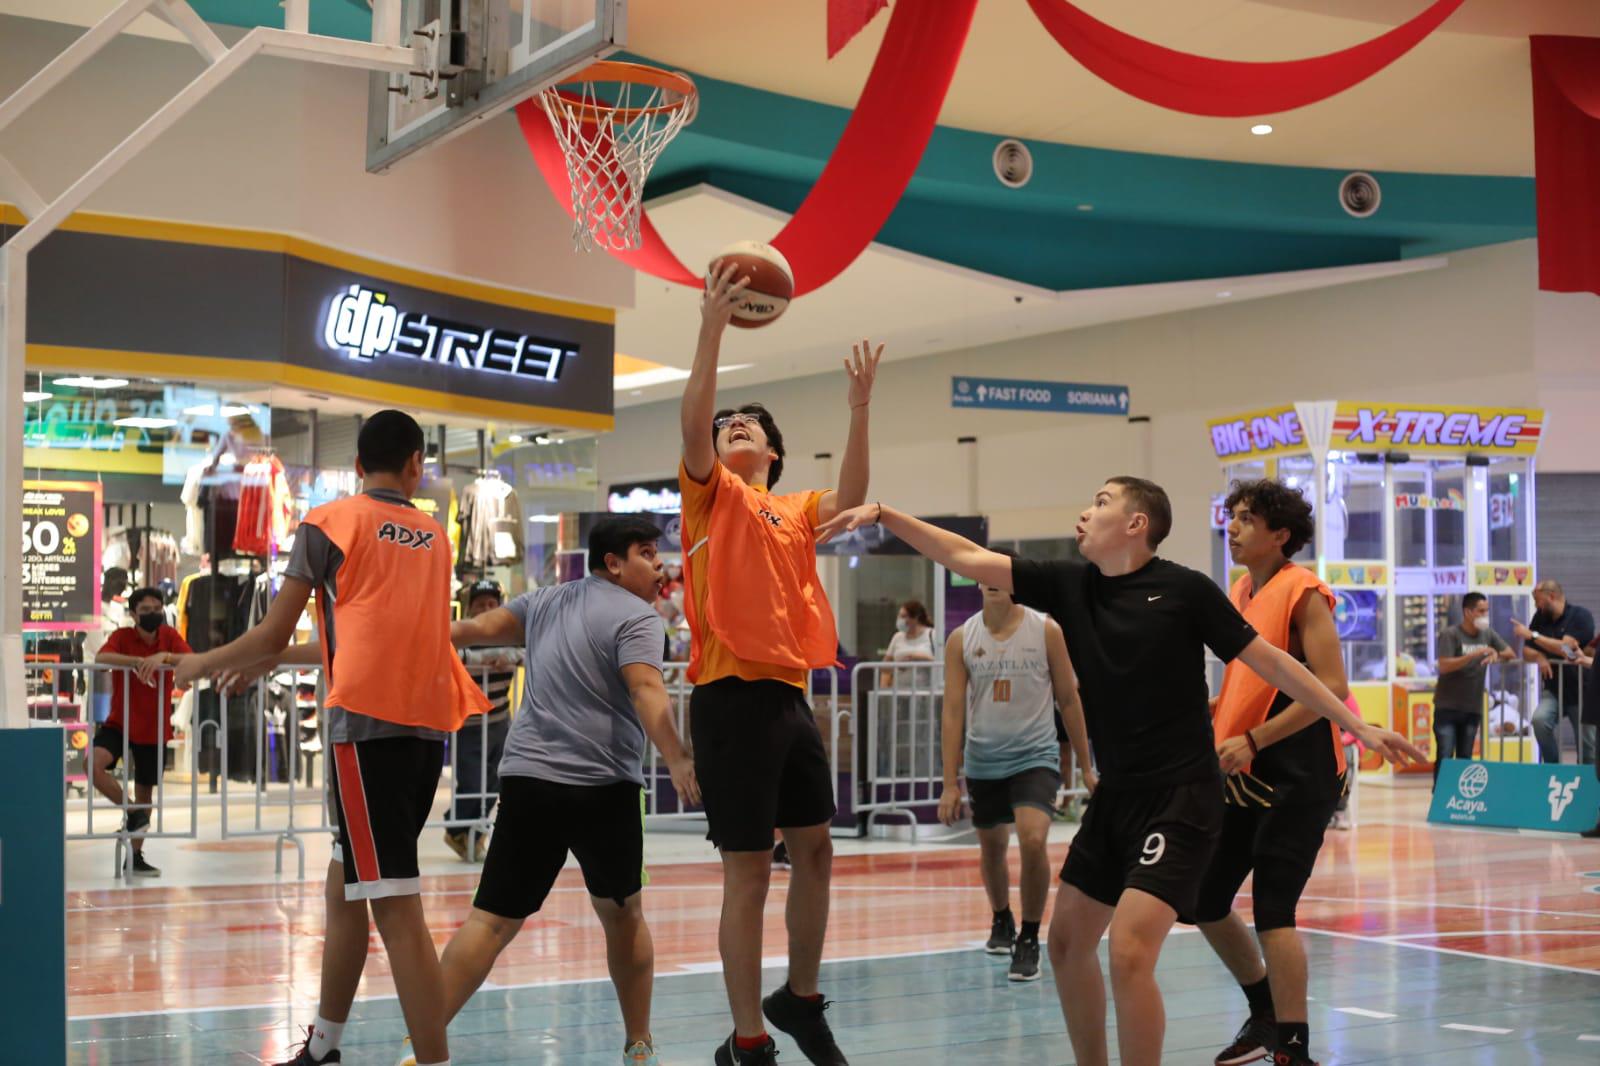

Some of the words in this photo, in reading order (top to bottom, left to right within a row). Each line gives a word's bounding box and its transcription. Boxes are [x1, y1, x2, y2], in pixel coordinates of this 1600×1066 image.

[394, 312, 580, 382] STREET
[989, 387, 1017, 401] FAST
[1019, 388, 1052, 403] FOOD
[1067, 391, 1117, 406] SORIANA
[1211, 420, 1252, 457] BIG
[1250, 411, 1303, 450] ONE
[377, 521, 435, 550] ADX
[1139, 832, 1166, 866] 9
